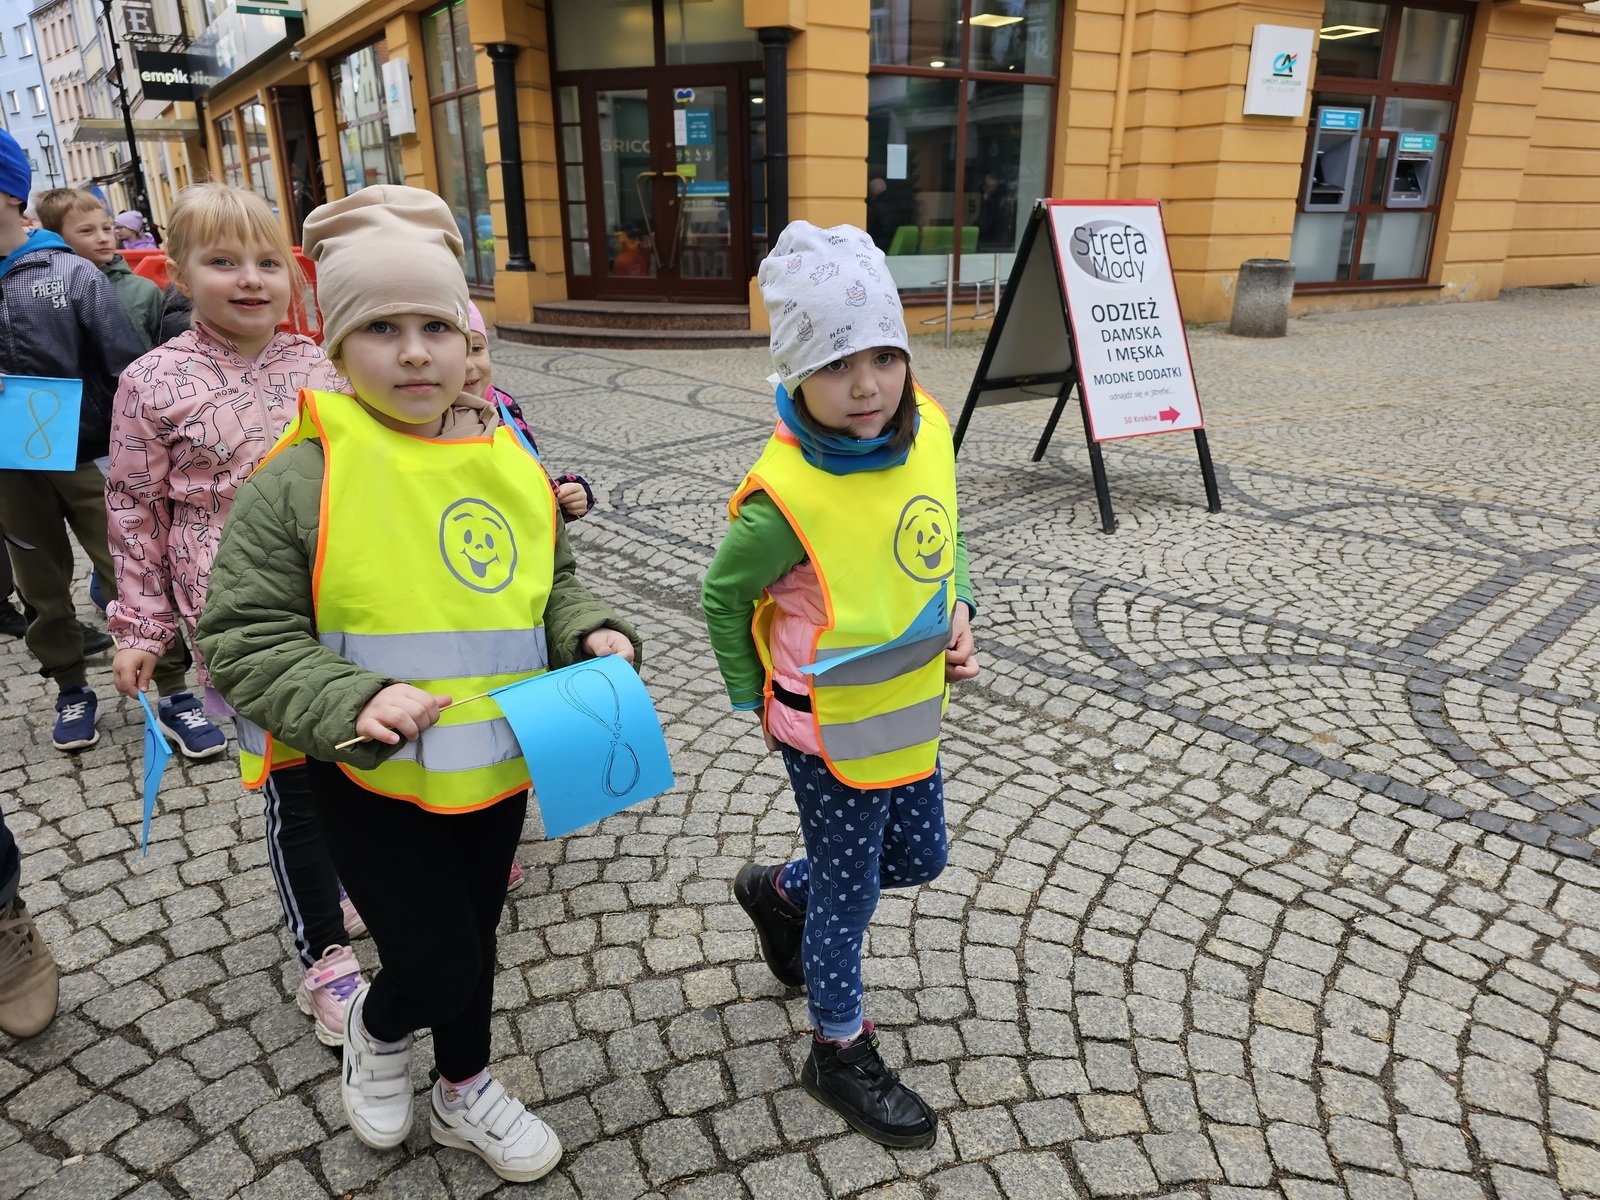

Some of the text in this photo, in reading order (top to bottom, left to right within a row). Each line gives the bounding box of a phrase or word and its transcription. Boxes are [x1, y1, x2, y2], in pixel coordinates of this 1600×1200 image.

[141, 67, 189, 85] empik
[1073, 225, 1148, 256] Strefa
[1092, 255, 1145, 283] Mody
[32, 280, 65, 298] FRESH
[1091, 297, 1160, 323] ODZIEŻ
[1101, 326, 1162, 343] DAMSKA
[1107, 344, 1165, 363] I MĘSKA
[1093, 367, 1182, 386] MODNE DODATKI
[1124, 416, 1133, 424] 50
